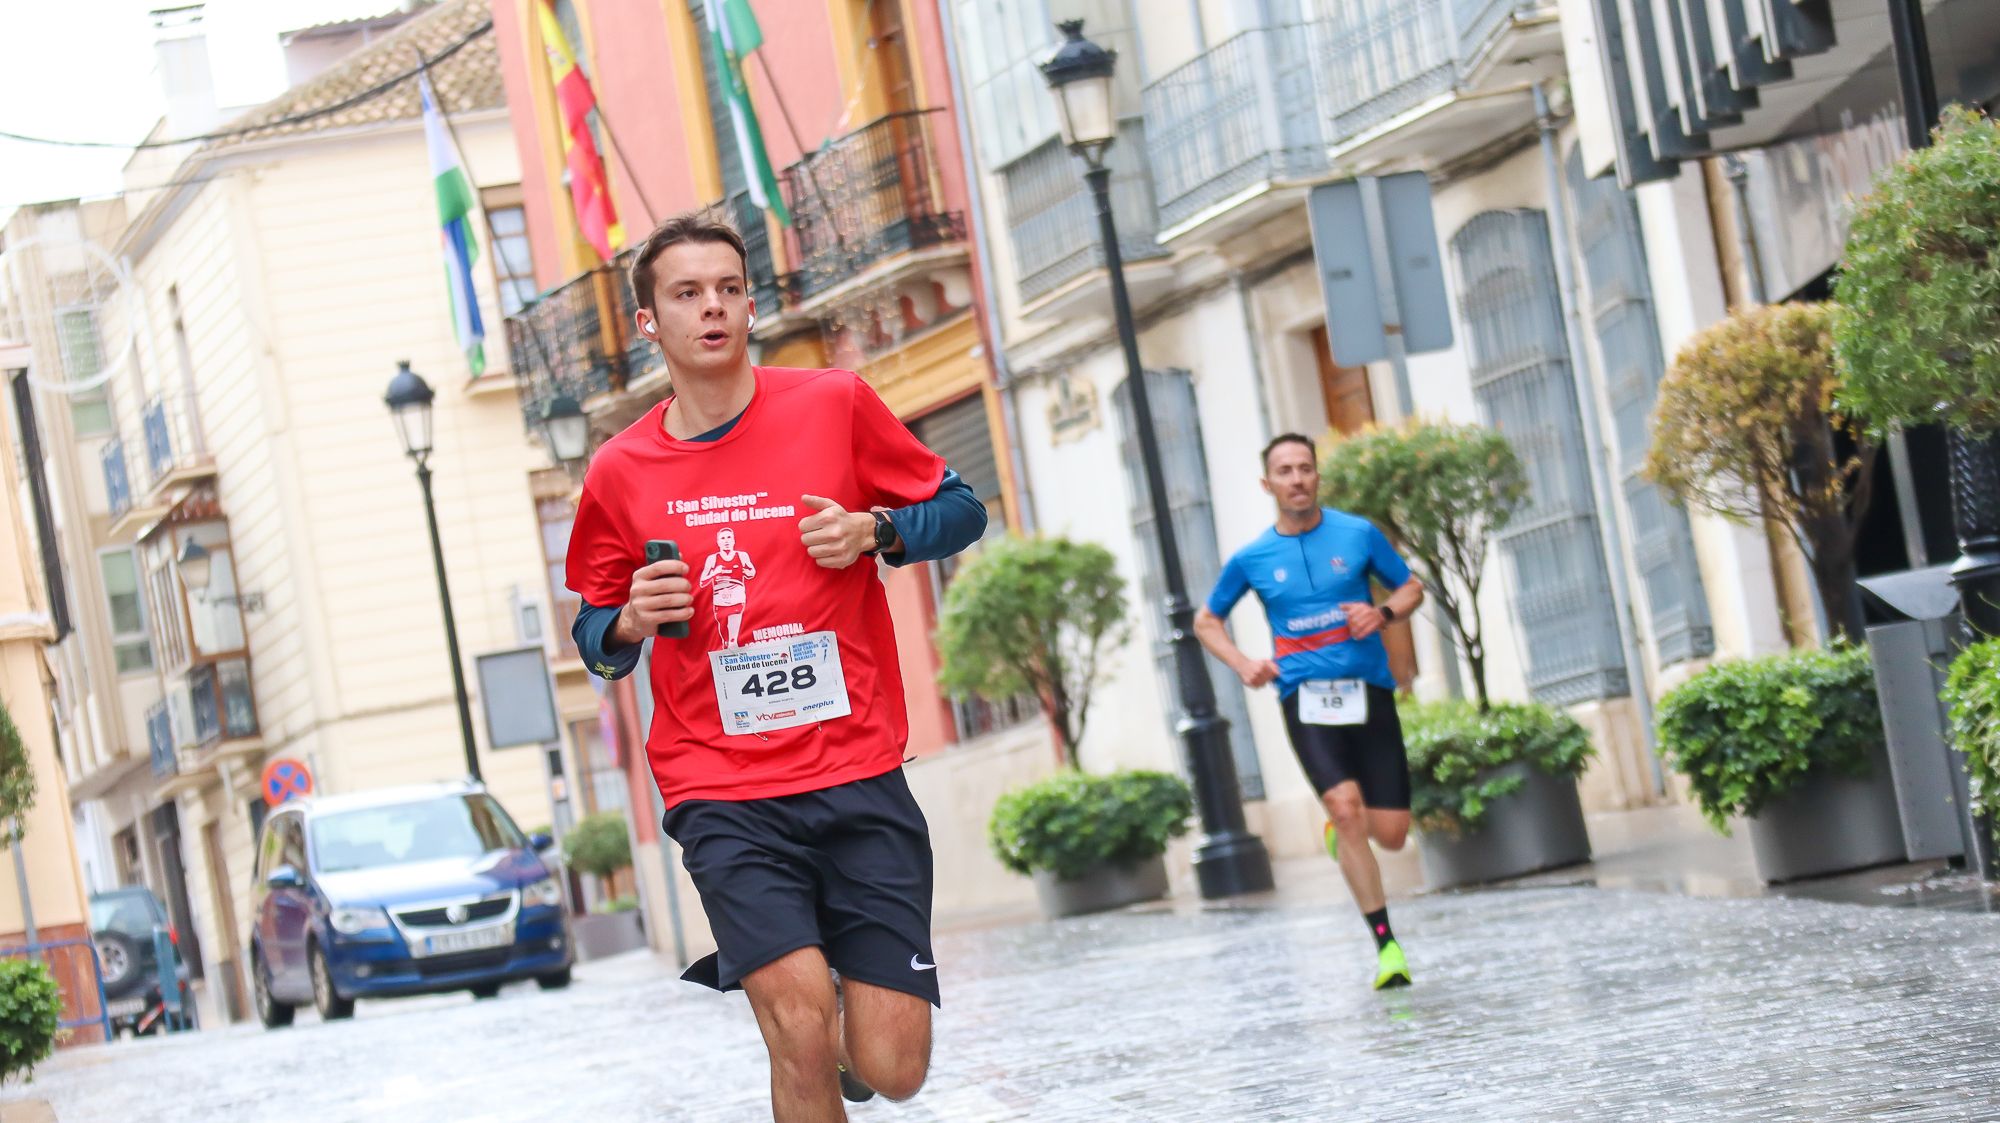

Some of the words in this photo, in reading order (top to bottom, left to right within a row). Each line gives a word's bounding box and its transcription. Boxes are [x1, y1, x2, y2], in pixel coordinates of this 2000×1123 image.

[666, 501, 674, 514] I
[675, 499, 700, 513] San
[700, 494, 757, 511] Silvestre
[685, 510, 730, 527] Ciudad
[731, 509, 747, 522] de
[749, 505, 795, 520] Lucena
[752, 622, 805, 641] MEMORIAL
[725, 657, 738, 665] San
[739, 653, 771, 664] Silvestre
[725, 662, 751, 672] Ciudad
[752, 661, 761, 669] de
[762, 658, 788, 668] Lucena
[741, 664, 817, 698] 428
[802, 699, 835, 711] enerplus
[1321, 696, 1344, 709] 18
